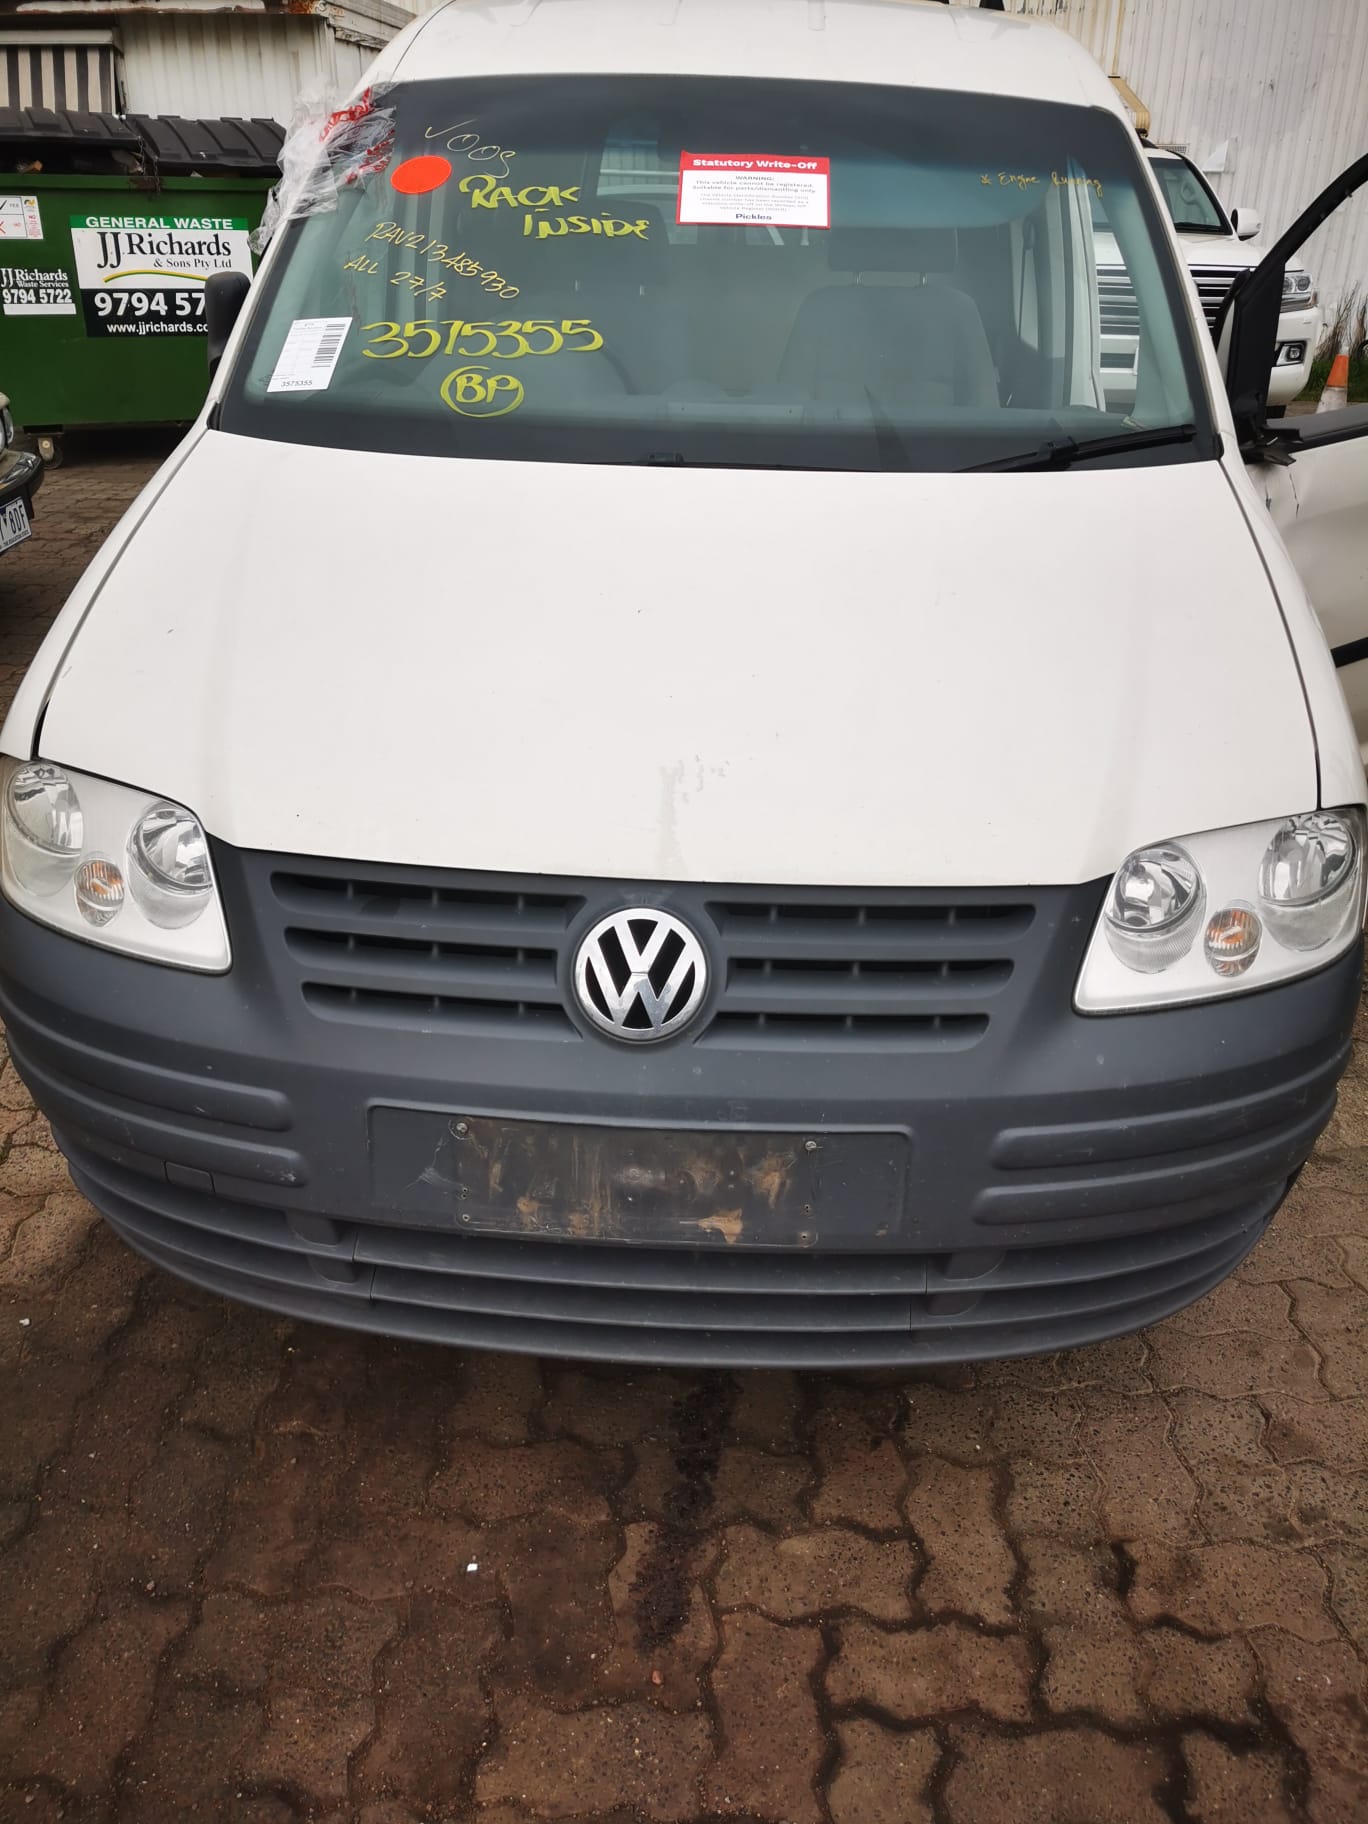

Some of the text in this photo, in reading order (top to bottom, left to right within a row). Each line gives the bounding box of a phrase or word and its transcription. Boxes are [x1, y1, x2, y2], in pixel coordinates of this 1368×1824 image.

[693, 159, 817, 170] Statutory Write-Off
[85, 216, 233, 230] GENERAL WASTE
[125, 232, 232, 257] Richards
[153, 259, 232, 269] & Sons Pty Ltd
[14, 268, 68, 281] Richards
[16, 280, 69, 288] Waste Services
[2, 288, 73, 304] 9794 5722
[94, 292, 206, 316] 9794 57
[106, 321, 209, 335] www.jjrichards.co
